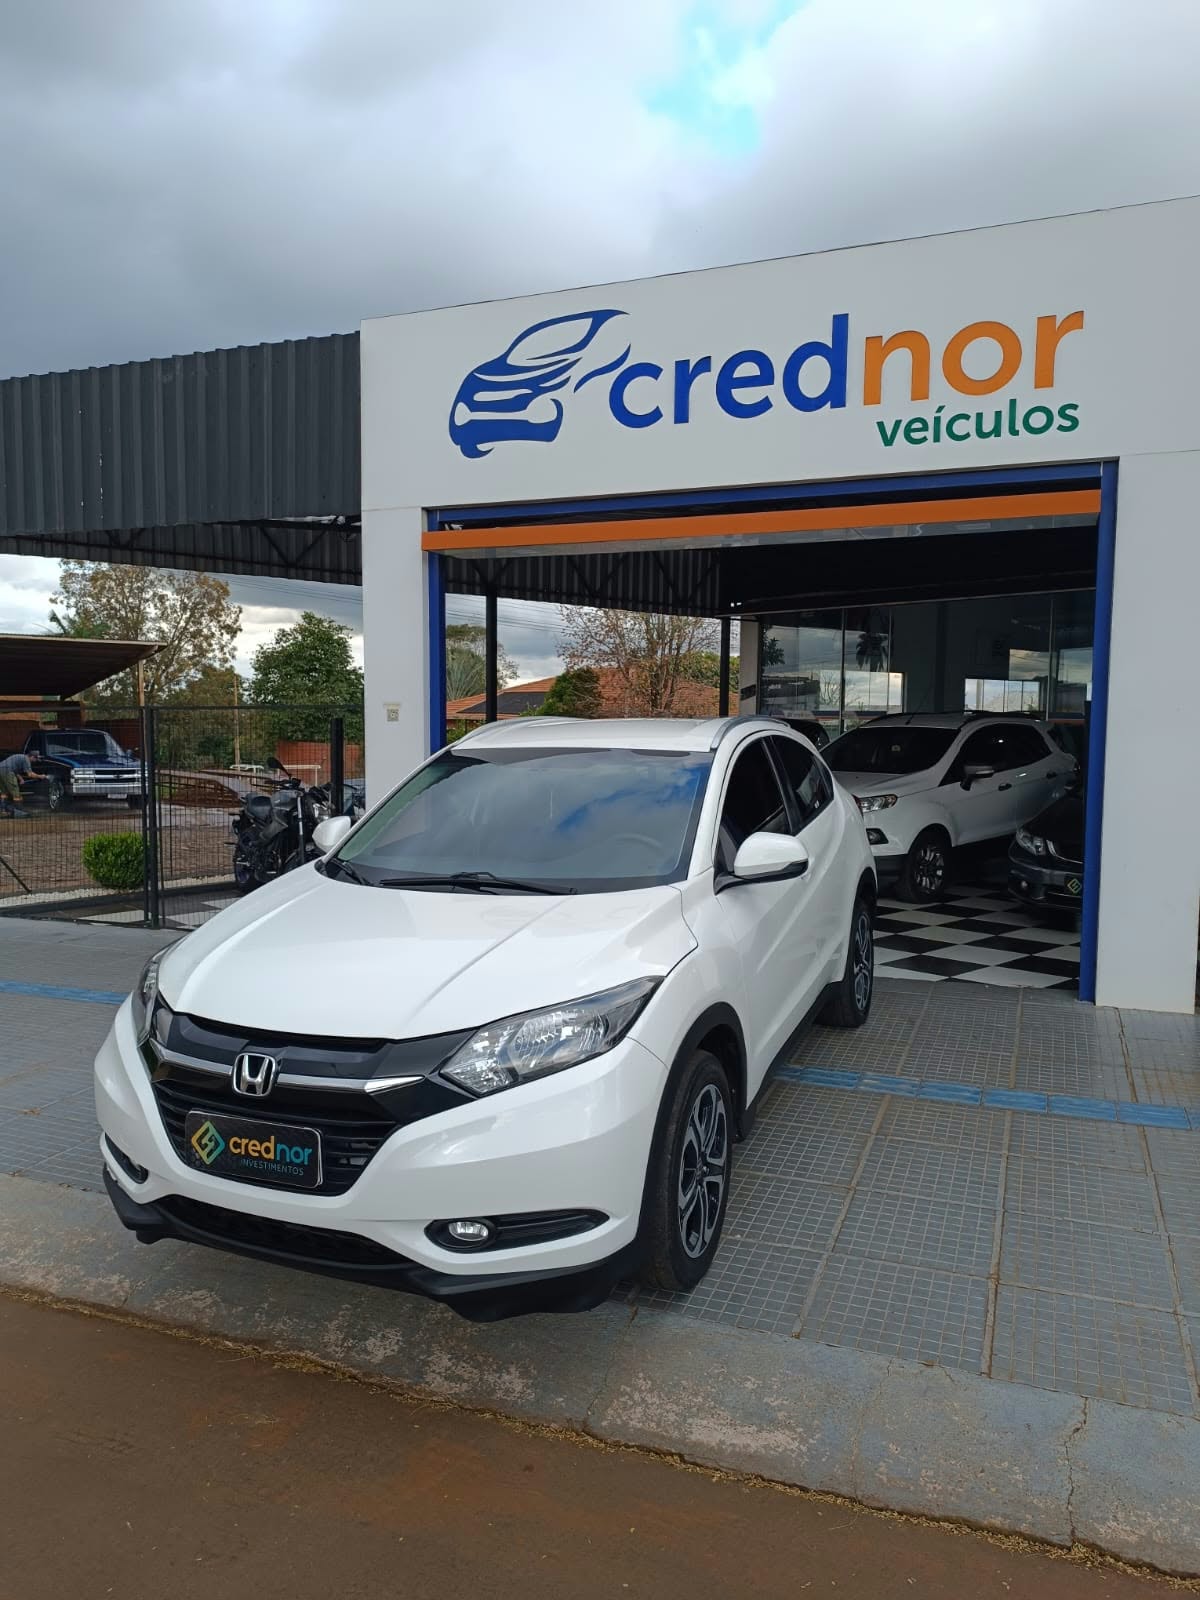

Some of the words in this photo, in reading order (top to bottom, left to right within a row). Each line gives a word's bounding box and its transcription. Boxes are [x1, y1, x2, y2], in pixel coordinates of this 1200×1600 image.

[609, 310, 1084, 428] crednor
[876, 399, 1080, 447] veículos
[229, 1136, 312, 1165] crednor
[242, 1158, 304, 1176] INVESTIMENTOS
